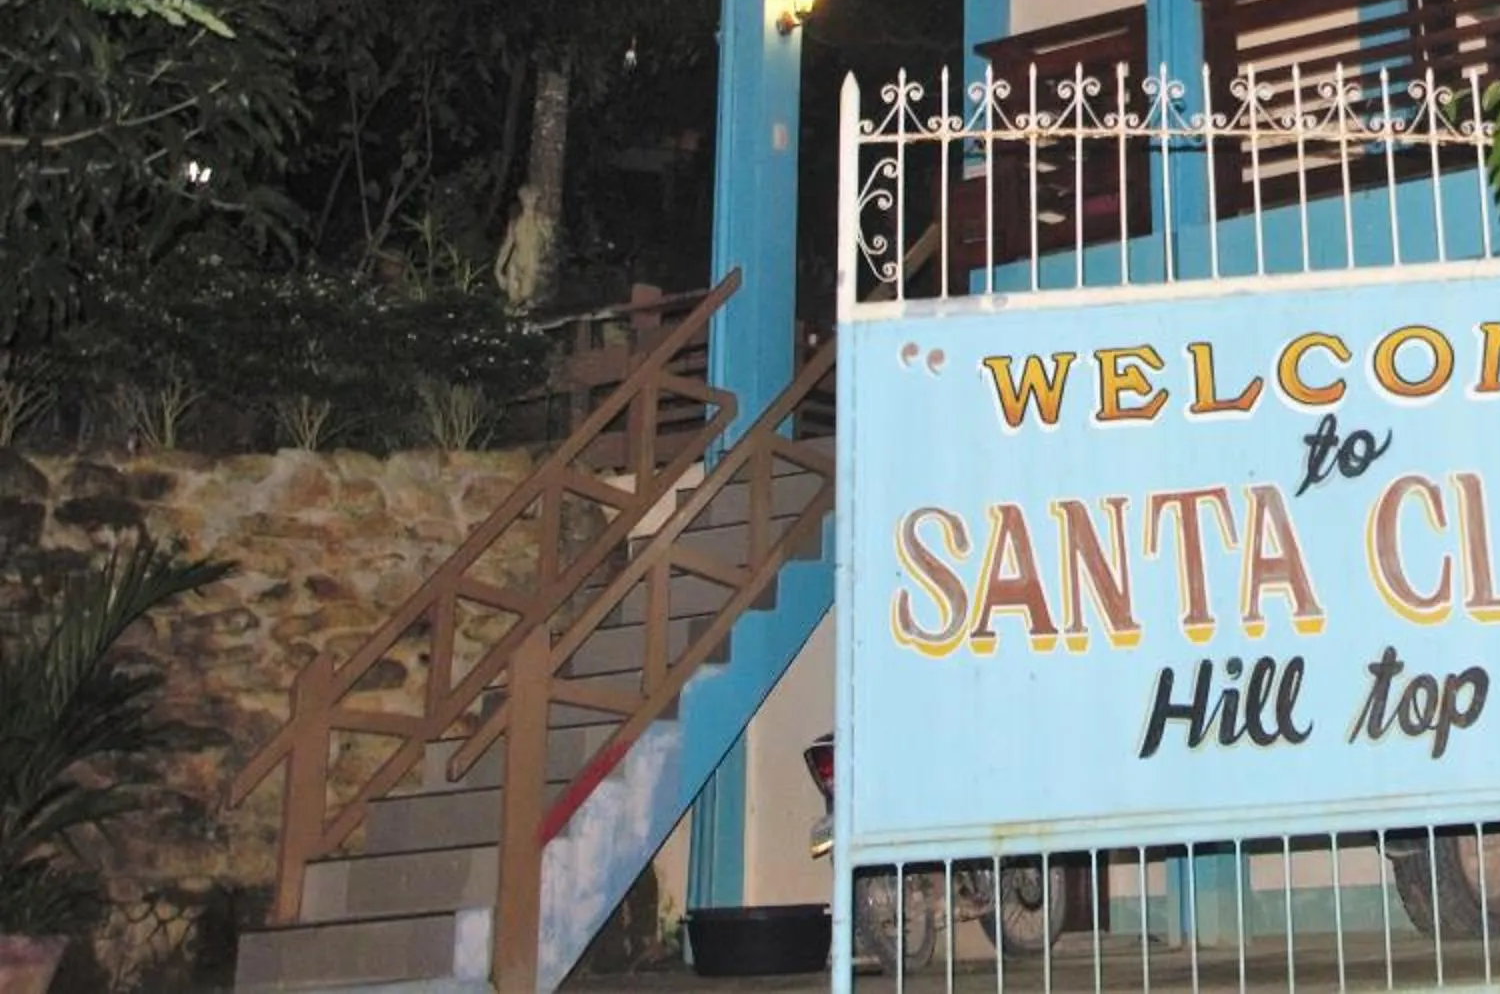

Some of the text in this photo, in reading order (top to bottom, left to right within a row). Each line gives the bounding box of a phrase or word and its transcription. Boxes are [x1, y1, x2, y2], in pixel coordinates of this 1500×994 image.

[1296, 413, 1393, 496] to
[893, 484, 1325, 658] SANTA
[1138, 645, 1491, 760] Hill top
